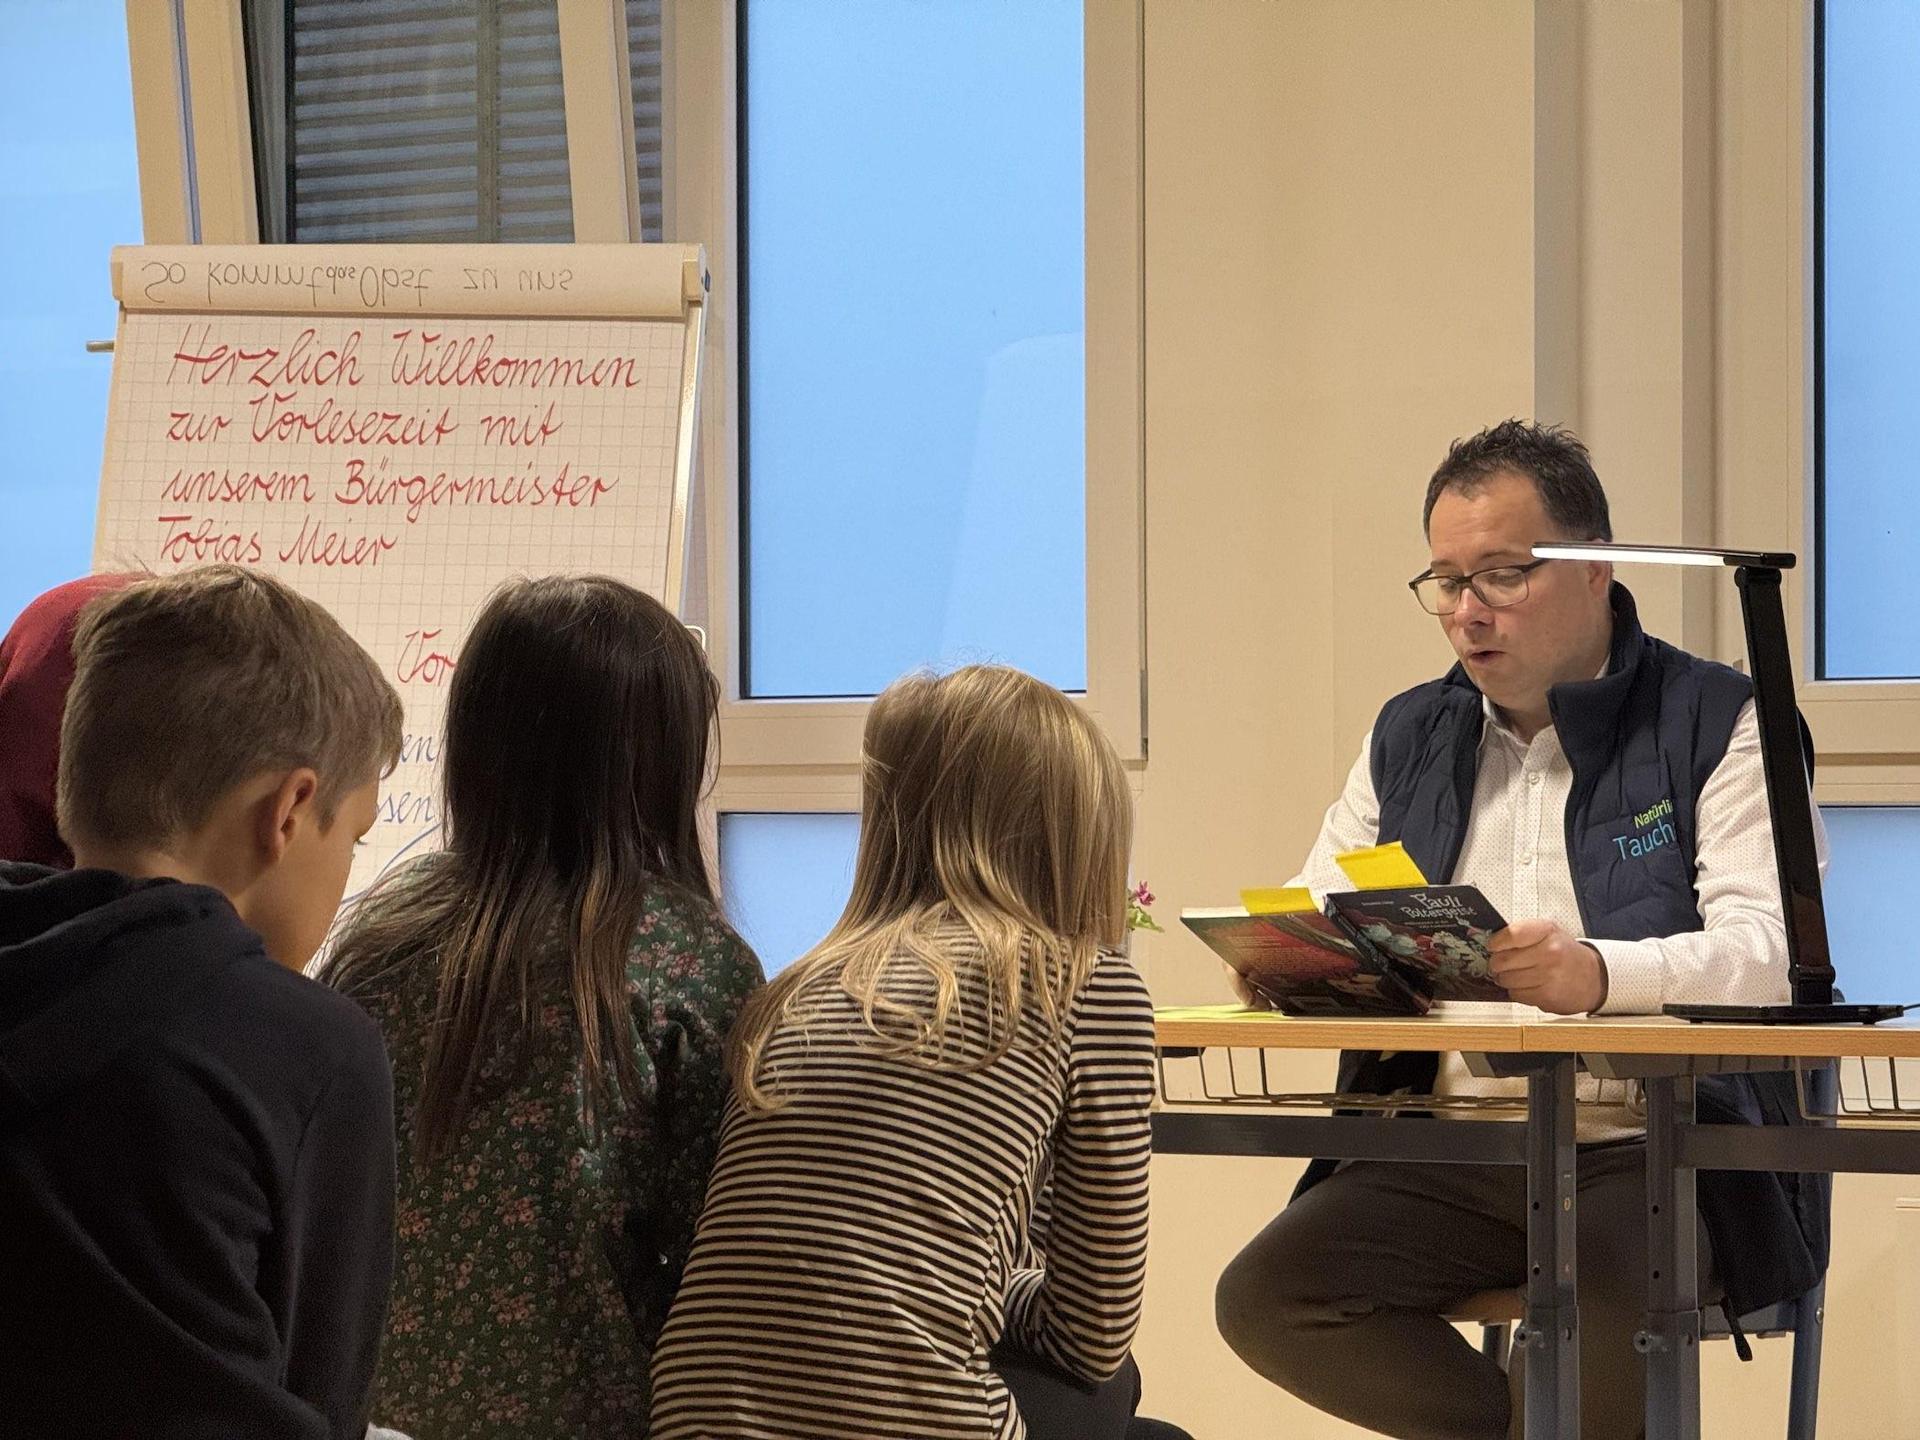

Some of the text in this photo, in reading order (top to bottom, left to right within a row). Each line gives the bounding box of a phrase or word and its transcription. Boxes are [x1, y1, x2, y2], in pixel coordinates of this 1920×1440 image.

[166, 322, 641, 389] Herzlich Willkommen
[166, 392, 563, 446] zur Vorlesezeit mit
[161, 457, 619, 523] unserem Bürgermeister
[158, 513, 399, 567] Tobias Meier
[397, 628, 456, 685] Vor
[400, 733, 436, 763] en
[376, 791, 435, 824] sen
[1633, 799, 1673, 829] Natürli
[1612, 818, 1676, 860] Tauch
